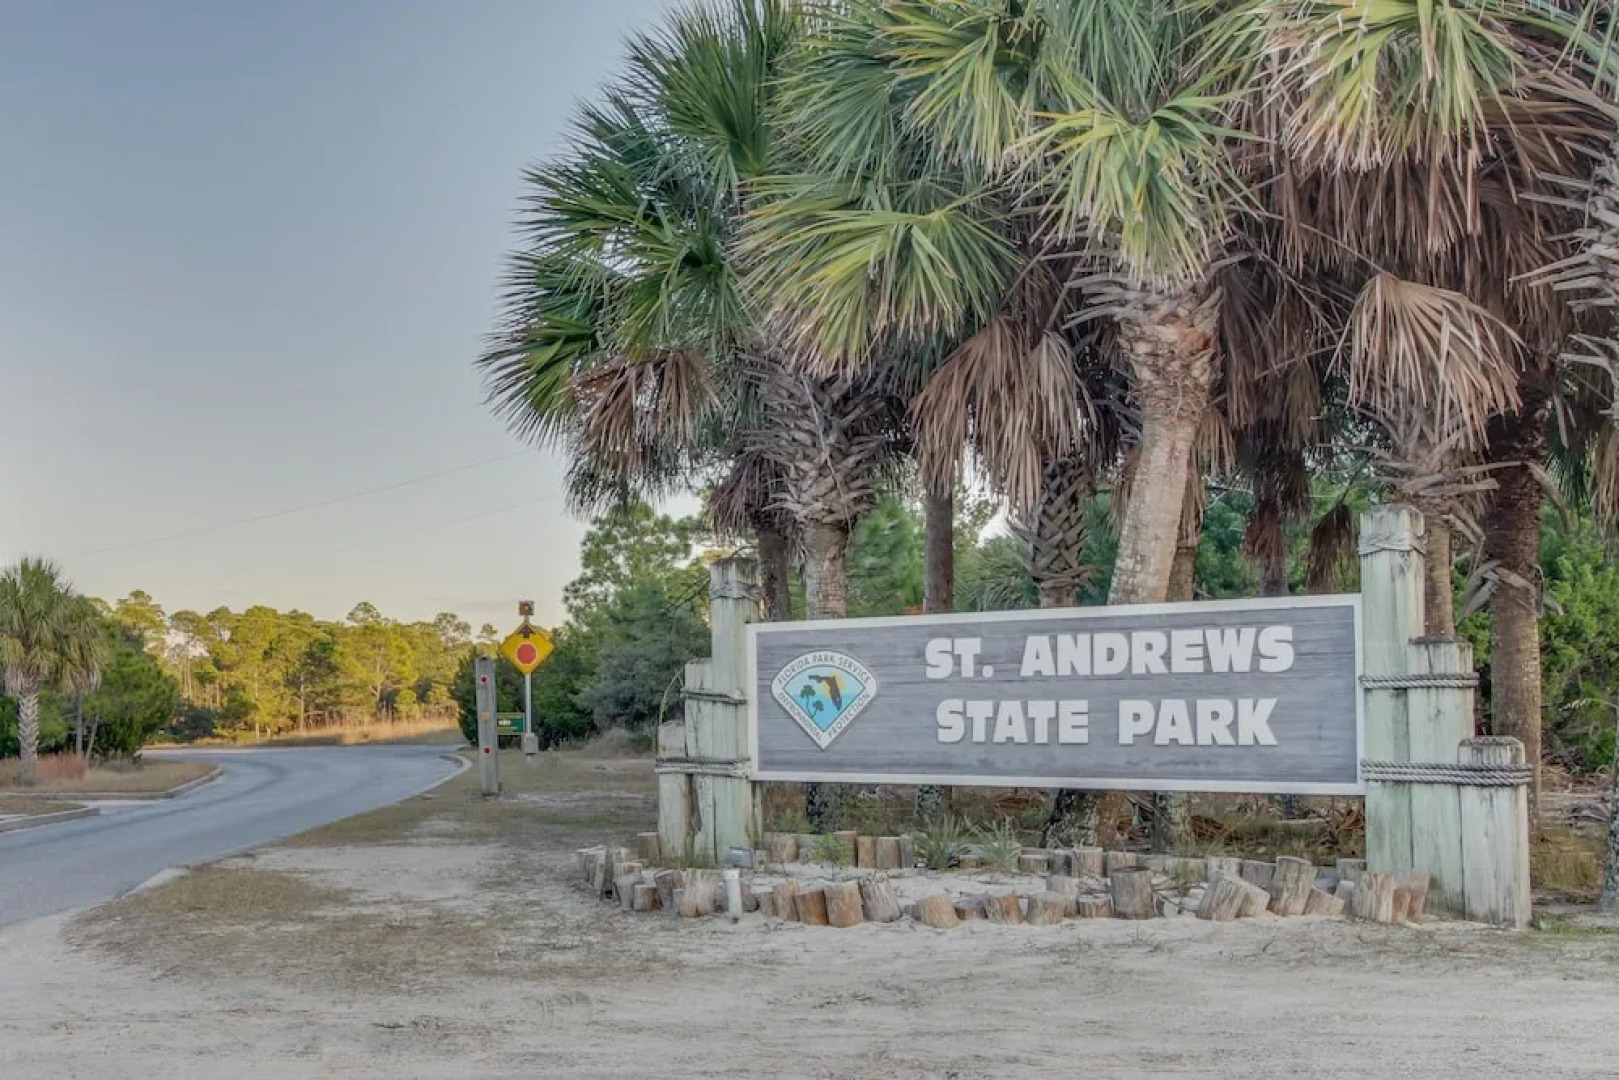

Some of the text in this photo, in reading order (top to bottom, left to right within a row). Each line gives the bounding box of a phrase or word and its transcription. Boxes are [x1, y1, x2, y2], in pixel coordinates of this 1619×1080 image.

[777, 654, 872, 685] FLORIDA PARK SERVICE
[925, 626, 1295, 680] ST. ANDREWS
[828, 692, 871, 738] PROTECTION
[936, 698, 1279, 746] STATE PARK
